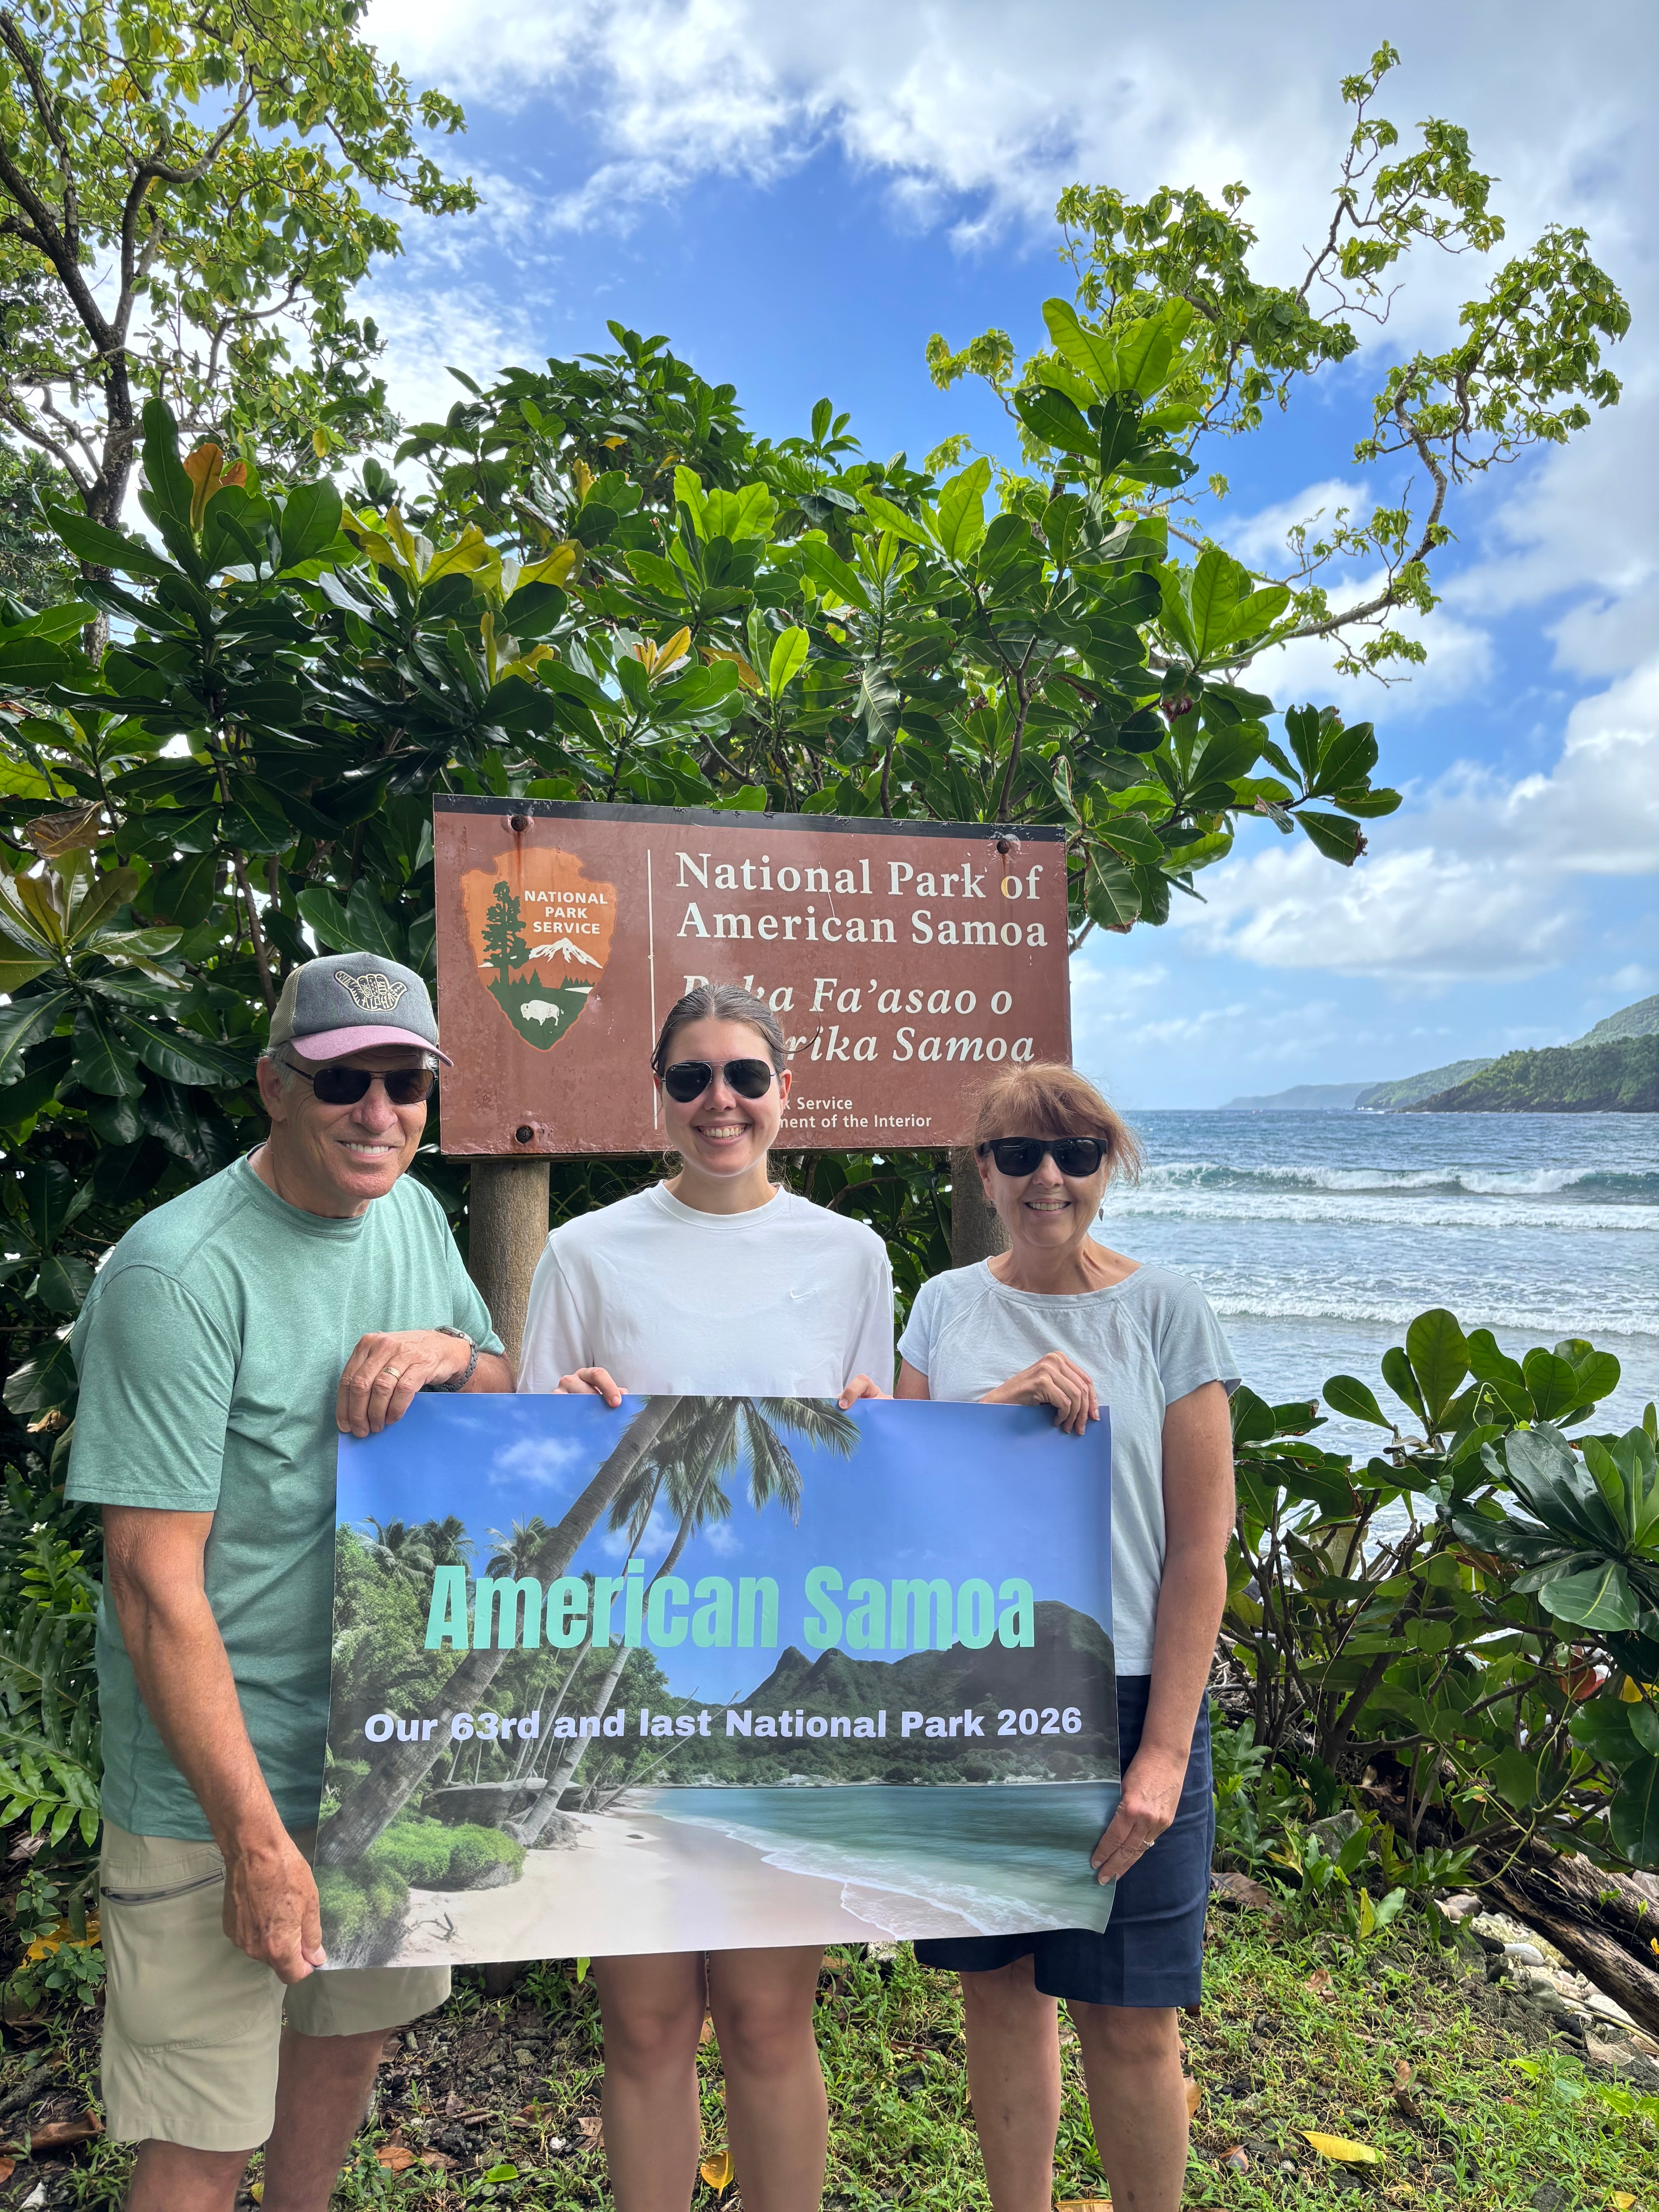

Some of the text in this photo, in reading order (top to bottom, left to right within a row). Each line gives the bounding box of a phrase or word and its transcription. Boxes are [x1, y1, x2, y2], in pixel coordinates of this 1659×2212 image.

[675, 852, 1043, 900] National Park of
[524, 890, 608, 904] NATIONAL
[545, 906, 588, 919] PARK
[533, 921, 600, 934] SERVICE
[677, 902, 1048, 947] American Samoa
[362, 994, 395, 1009] ALOHA
[991, 990, 1012, 1015] o
[892, 1027, 1035, 1062] Samoa
[796, 1096, 853, 1110] Service
[821, 1114, 838, 1128] of
[842, 1114, 868, 1128] the
[874, 1114, 932, 1127] Interior
[424, 1559, 1035, 1650] American Samoa
[364, 1707, 1082, 1743] Our 63rd and last National Park 2026
